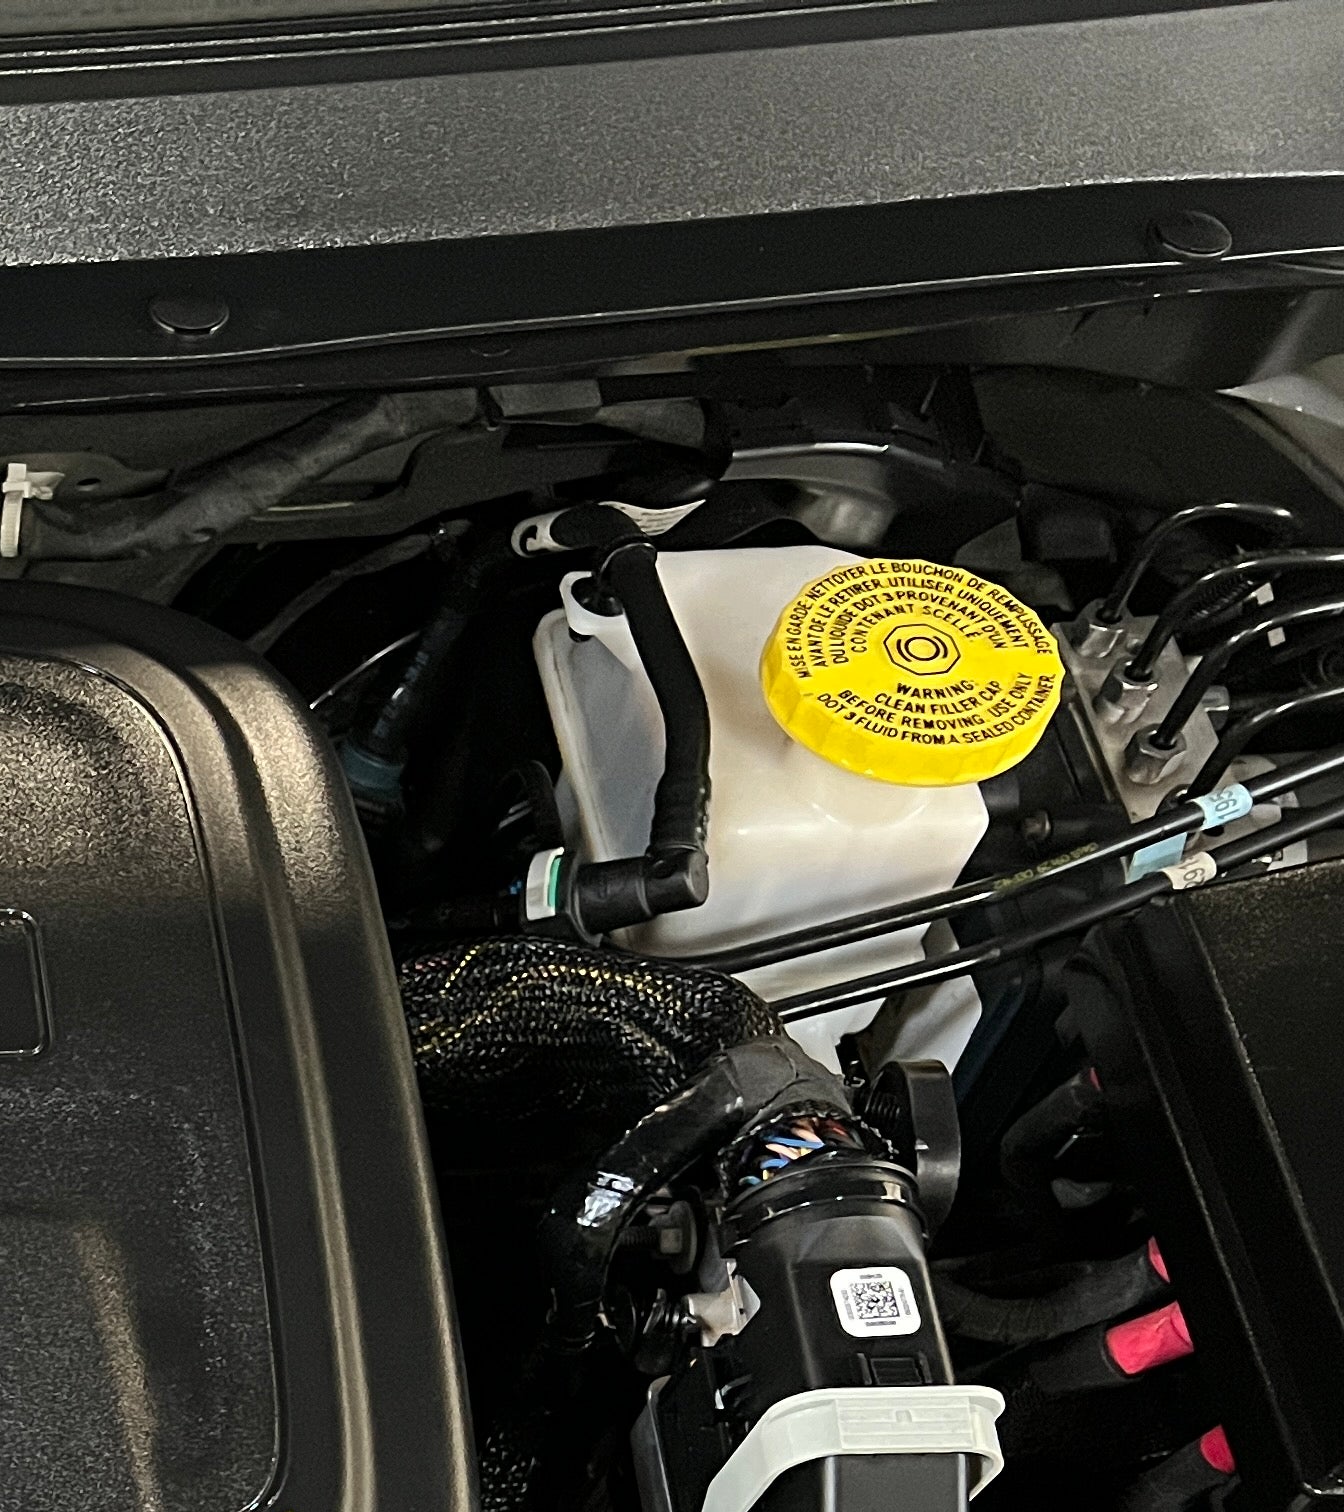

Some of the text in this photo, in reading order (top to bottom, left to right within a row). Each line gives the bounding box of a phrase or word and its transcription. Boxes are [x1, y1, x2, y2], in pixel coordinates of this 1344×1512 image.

[805, 565, 869, 601] NETTOYER
[869, 562, 890, 575] LE
[887, 576, 955, 595] UTILISER
[890, 562, 964, 584] BOUCHON
[966, 577, 988, 592] DE
[816, 604, 835, 619] LE
[852, 594, 883, 611] DOT
[882, 592, 894, 602] 3
[895, 590, 988, 624] PROVENANT
[957, 589, 1029, 648] UNIQUEMENT
[986, 588, 1053, 655] REMPLISSAGE
[809, 617, 827, 633] DE
[850, 603, 914, 653] CONTENANT
[786, 637, 802, 652] EN
[807, 632, 829, 667] AVANT
[788, 654, 812, 678] MISE
[837, 689, 897, 723] BEFORE
[987, 698, 1017, 718] USE
[1009, 672, 1033, 700] ONLY
[874, 680, 1004, 715] CLEAN FILLER CAP
[817, 692, 848, 713] DOT
[843, 711, 857, 721] 3
[854, 716, 899, 738] FLUID
[900, 730, 946, 745] FROM
[947, 734, 961, 744] A
[962, 720, 1015, 743] SEALED
